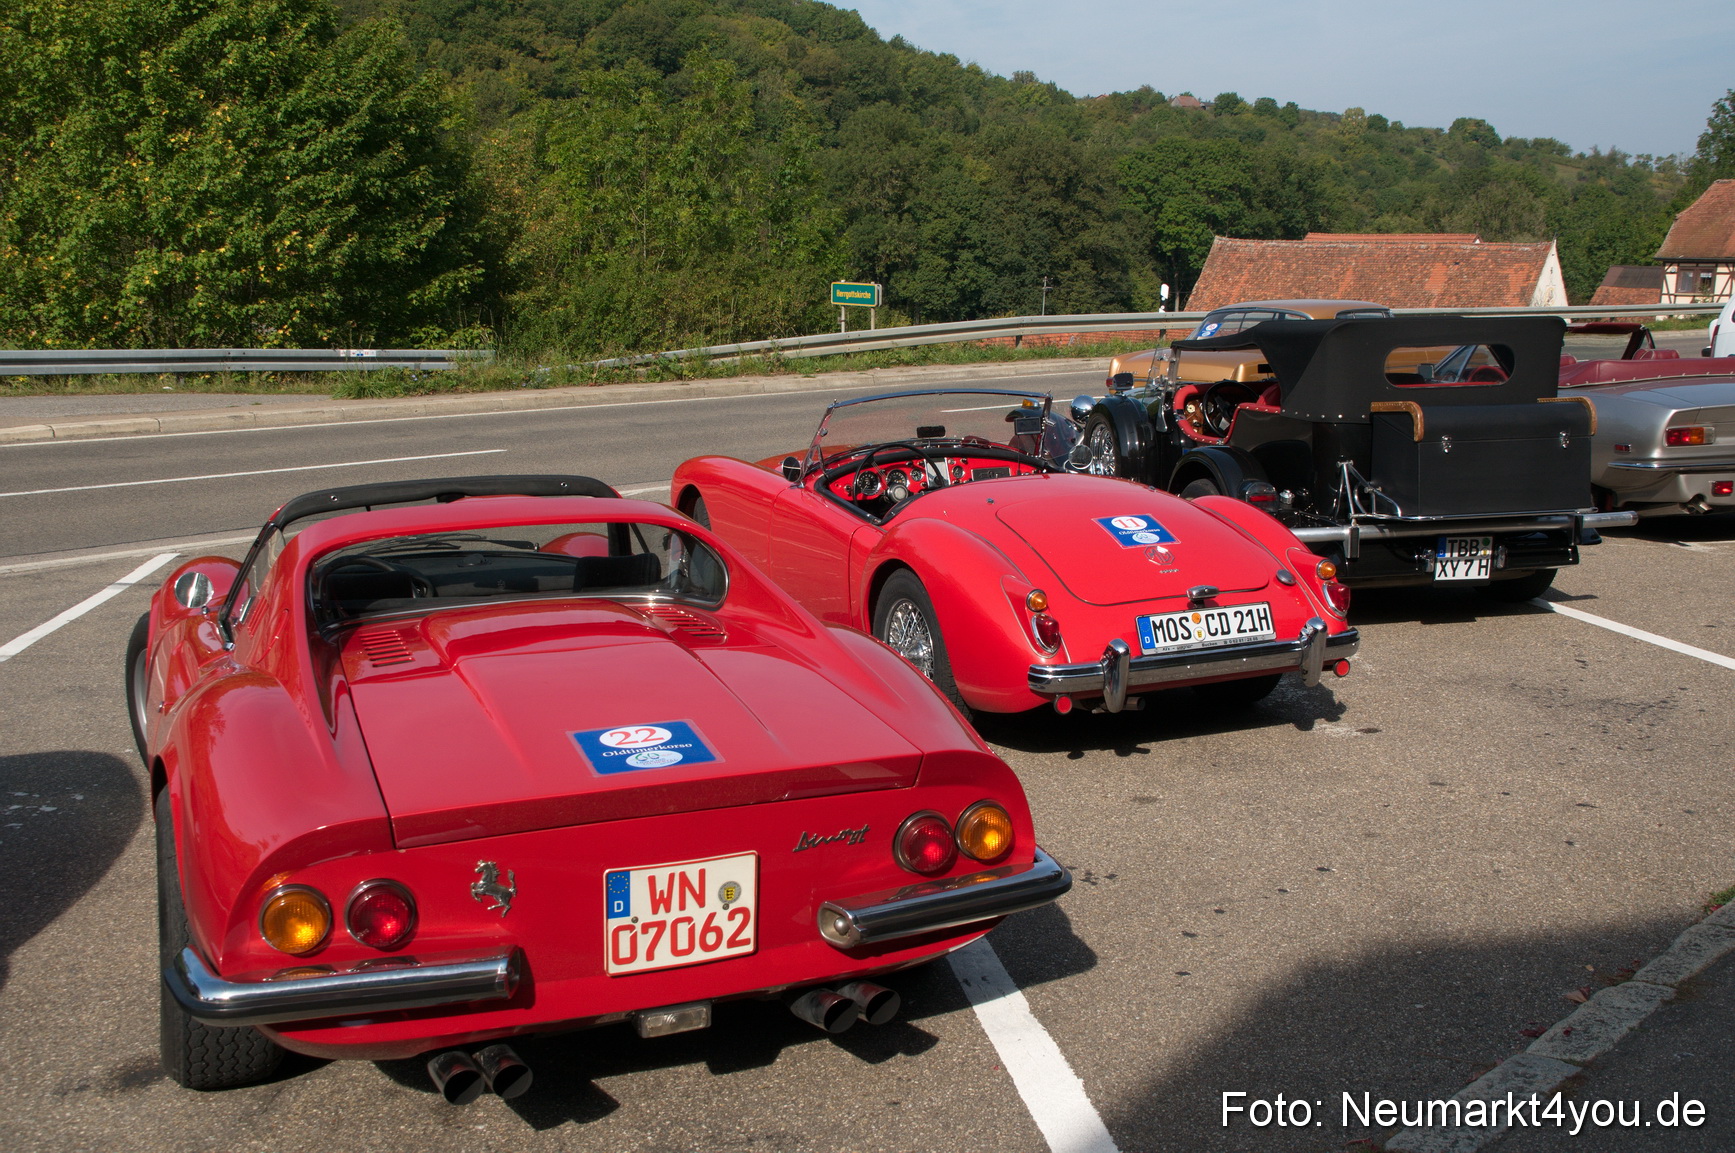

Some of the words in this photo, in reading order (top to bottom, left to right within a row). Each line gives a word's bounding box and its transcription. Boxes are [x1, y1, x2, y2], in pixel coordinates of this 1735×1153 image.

[1115, 518, 1143, 528] 11
[1448, 539, 1480, 557] TBB
[1437, 559, 1461, 577] XY
[1464, 559, 1475, 576] 7
[1478, 558, 1489, 576] H
[1152, 616, 1192, 643] MOS
[1205, 612, 1231, 637] CD
[1234, 608, 1270, 633] 21H
[609, 728, 664, 746] 22
[602, 742, 693, 758] Oldtimerkorso
[648, 868, 706, 915] WN
[614, 900, 624, 913] D
[611, 906, 751, 966] 07062
